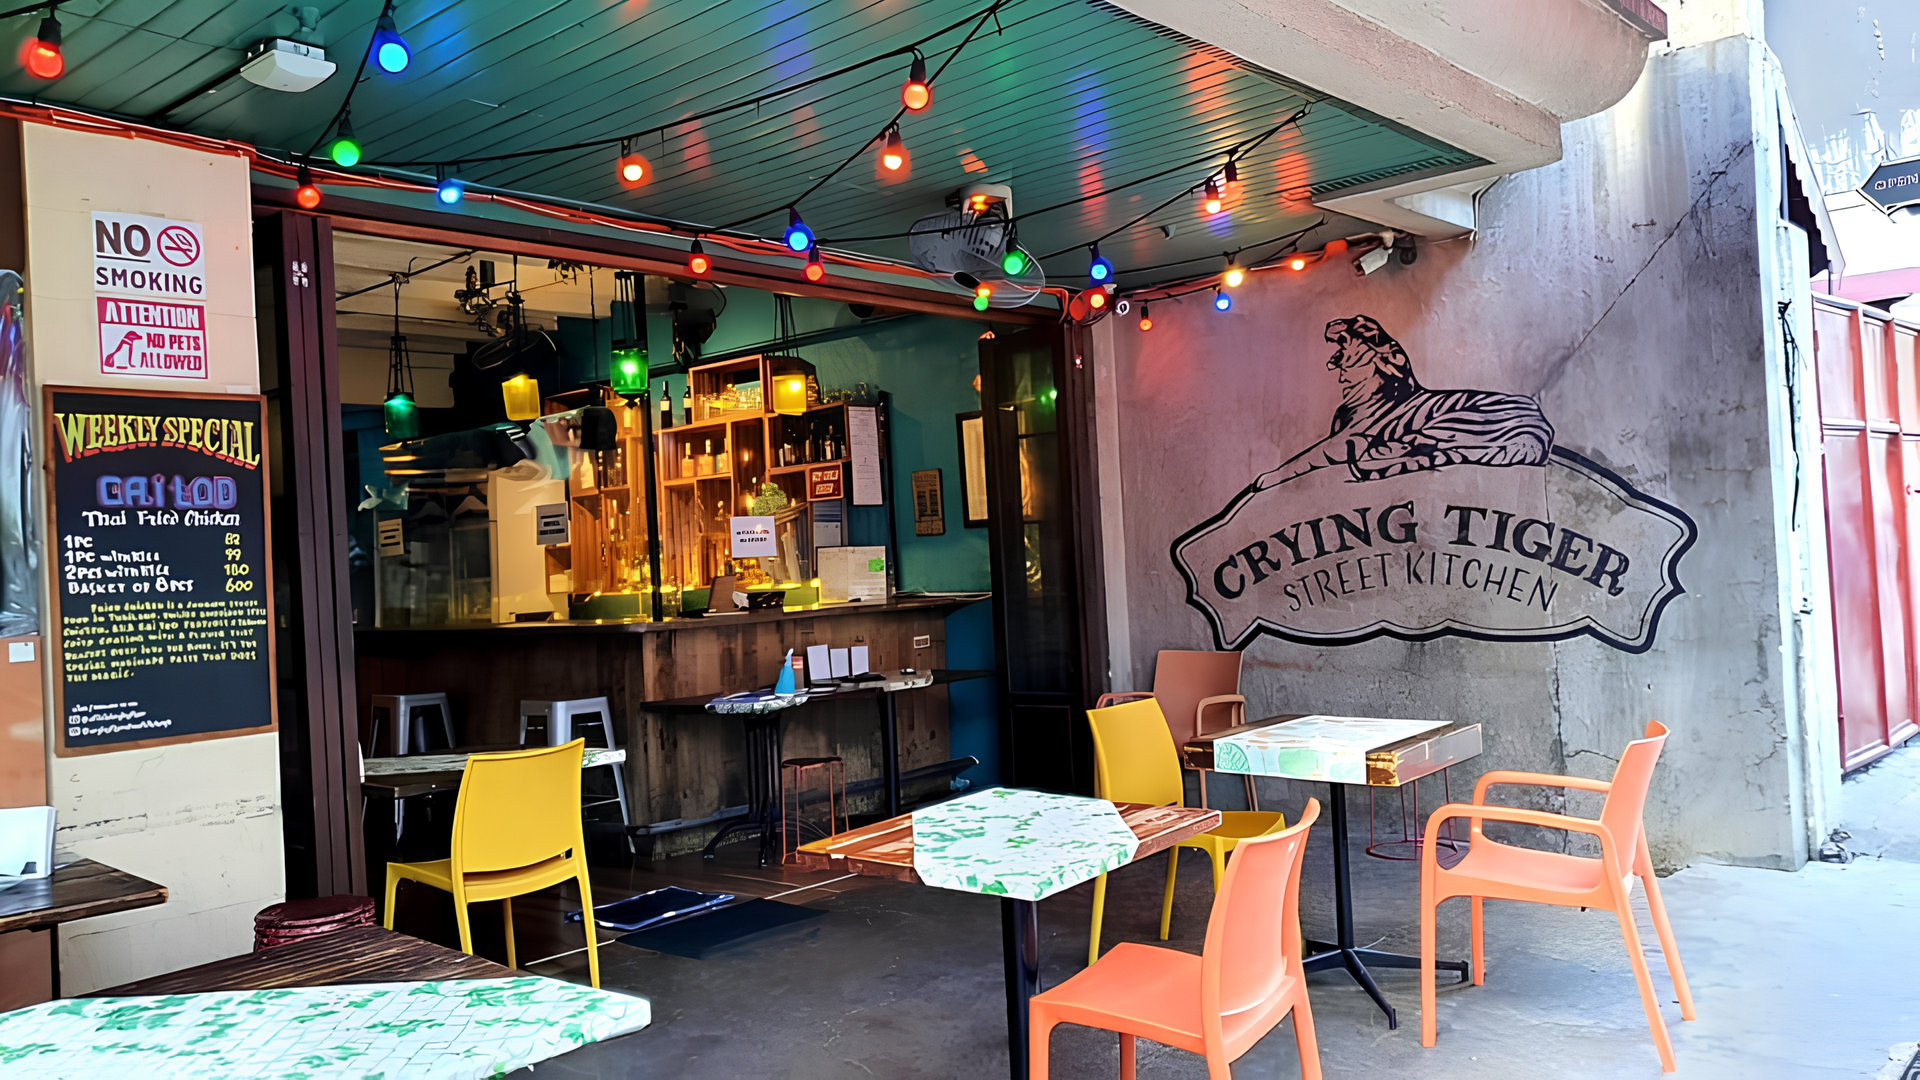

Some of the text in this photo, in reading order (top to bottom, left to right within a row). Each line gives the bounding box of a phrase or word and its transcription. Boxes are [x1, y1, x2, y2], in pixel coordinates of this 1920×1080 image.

[95, 219, 151, 257] NO
[96, 266, 203, 295] SMOKING
[105, 301, 200, 328] ATTENTION
[145, 332, 202, 351] NO PETS
[140, 352, 202, 371] ALLOWED
[54, 413, 261, 469] WEEKLY SPECIAL
[225, 548, 242, 561] 99
[1213, 501, 1630, 599] CRYING TIGER
[225, 577, 254, 593] 600
[1283, 550, 1558, 611] STREET KITCHEN
